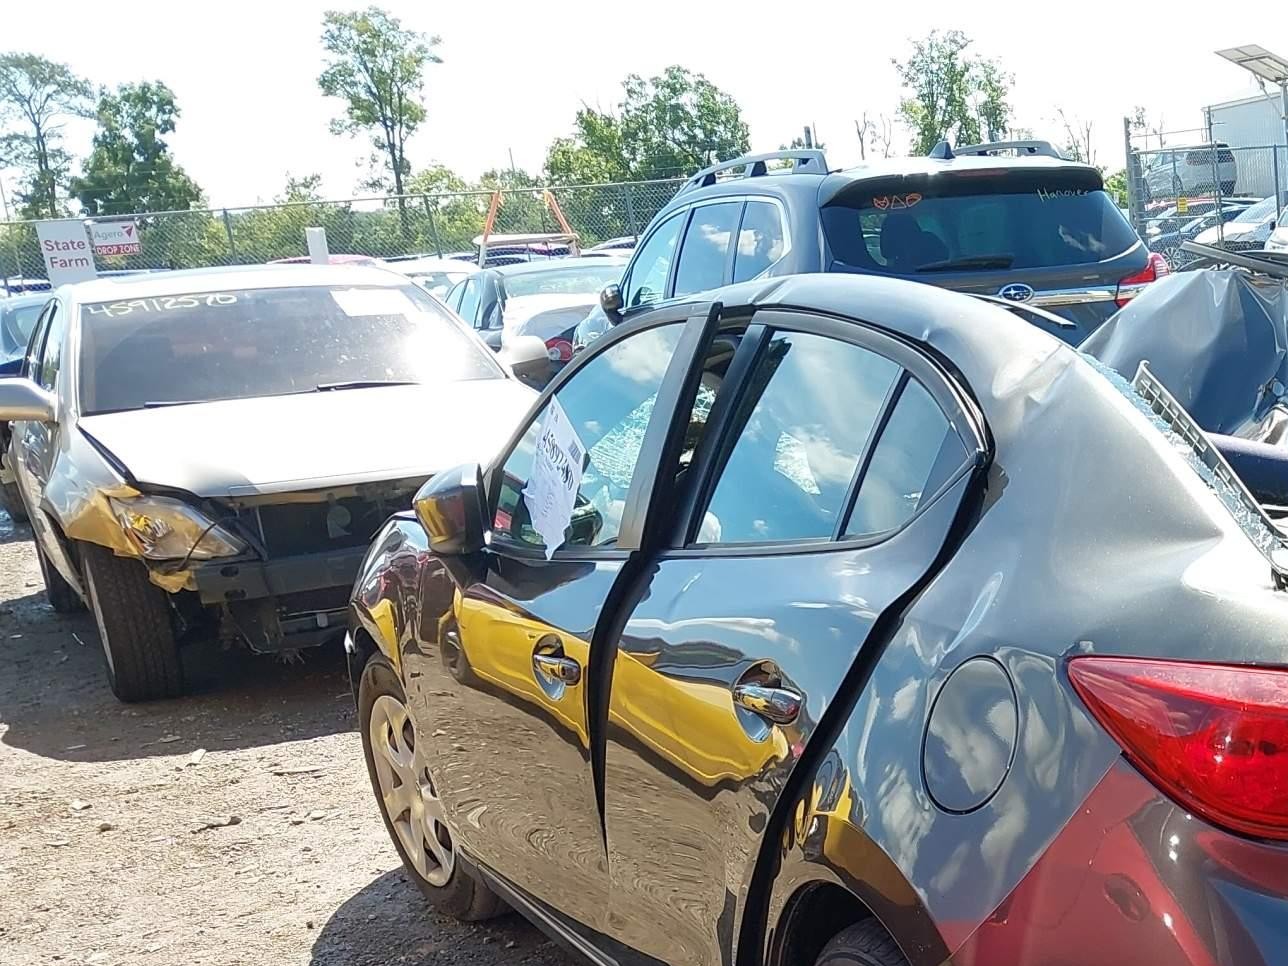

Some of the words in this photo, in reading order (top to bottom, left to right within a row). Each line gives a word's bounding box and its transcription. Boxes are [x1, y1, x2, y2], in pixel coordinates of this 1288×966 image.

[94, 231, 123, 240] Agero
[43, 240, 86, 252] State
[96, 246, 118, 255] DROP
[120, 244, 141, 254] ZONE
[49, 257, 89, 269] Farm
